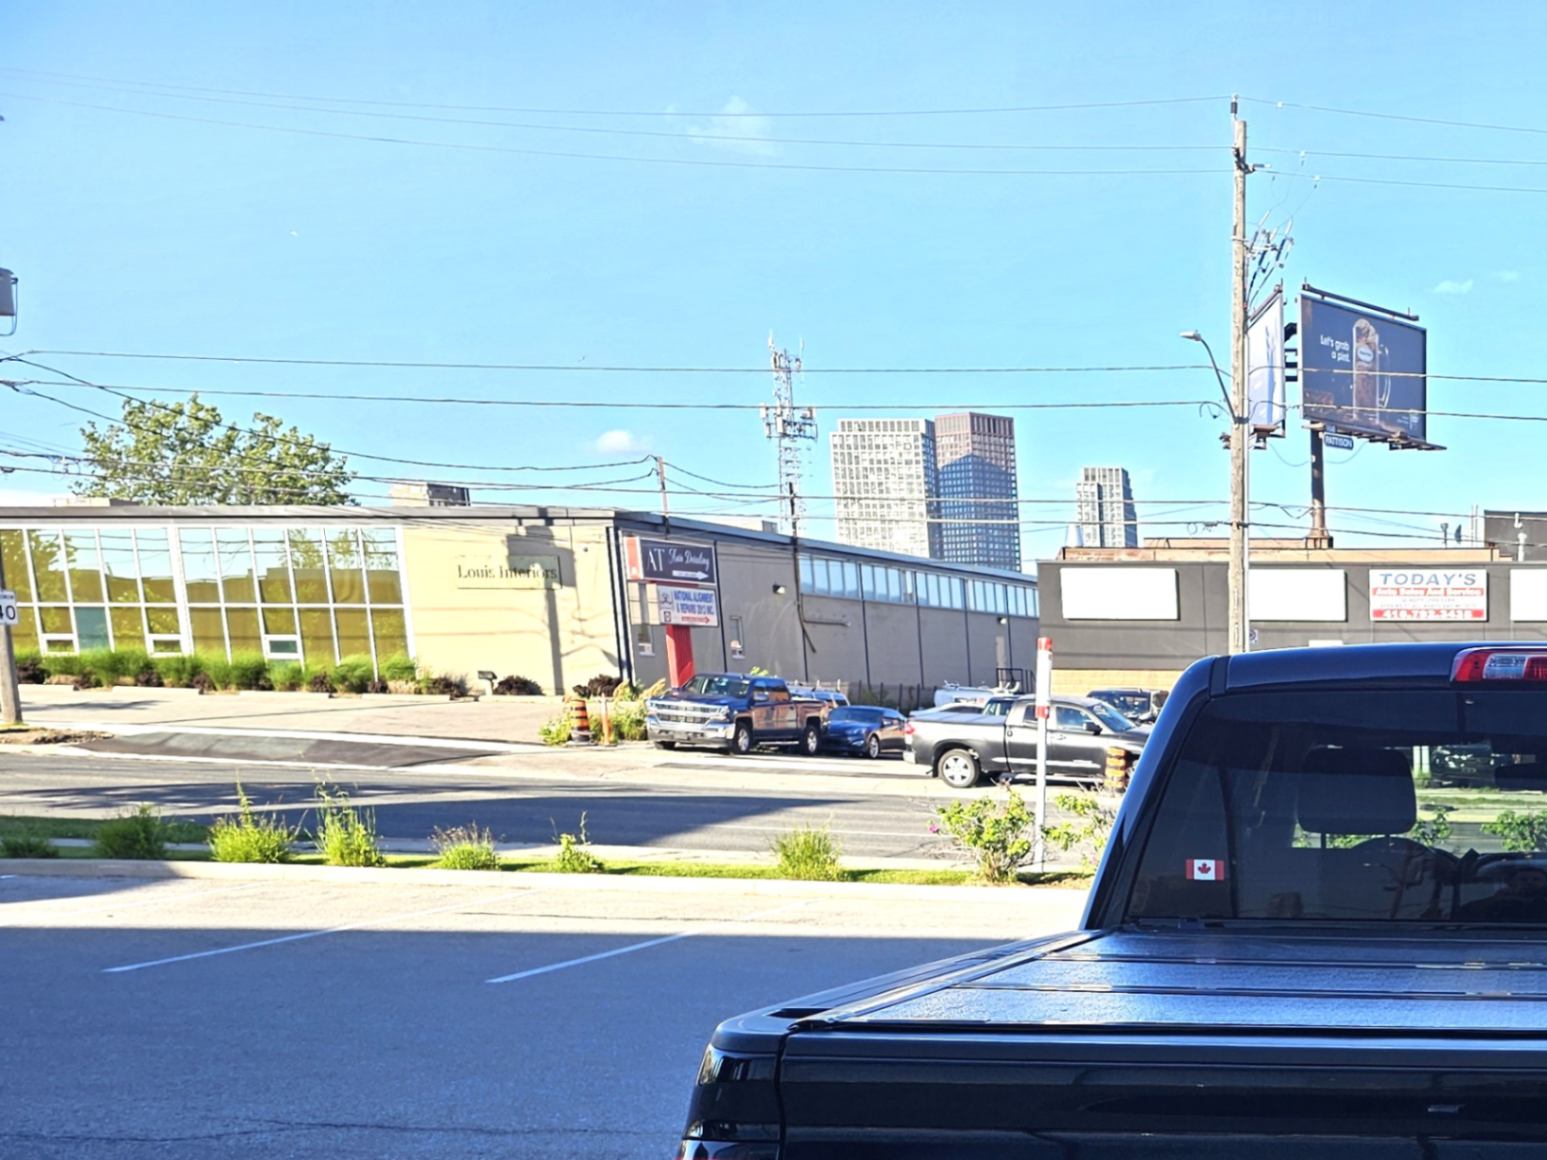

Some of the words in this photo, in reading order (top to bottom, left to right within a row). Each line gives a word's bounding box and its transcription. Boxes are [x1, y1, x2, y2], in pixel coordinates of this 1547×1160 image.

[1320, 334, 1334, 347] Let's
[1324, 435, 1353, 448] PATTISON
[646, 547, 665, 571] AT
[457, 565, 495, 578] Louis
[500, 565, 557, 579] Interiors
[1379, 573, 1477, 586] TODAY'S
